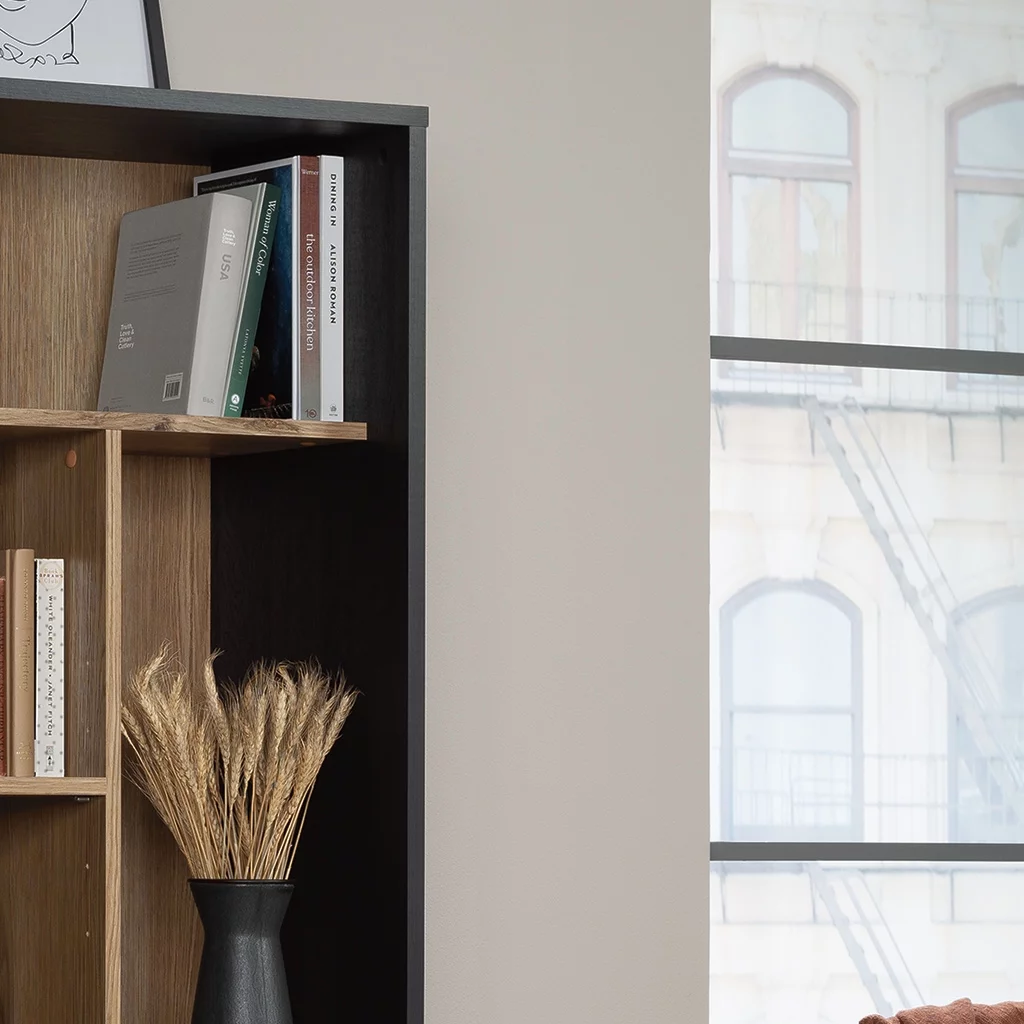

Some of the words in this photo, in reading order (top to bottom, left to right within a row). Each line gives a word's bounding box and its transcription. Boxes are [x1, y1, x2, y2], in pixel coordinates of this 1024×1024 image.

[261, 200, 277, 235] Woman
[330, 215, 337, 227] IN
[257, 235, 269, 250] of
[306, 233, 315, 252] the
[220, 254, 232, 281] USA
[255, 250, 268, 276] Color
[306, 256, 316, 305] outdoor
[306, 306, 316, 351] kitchen
